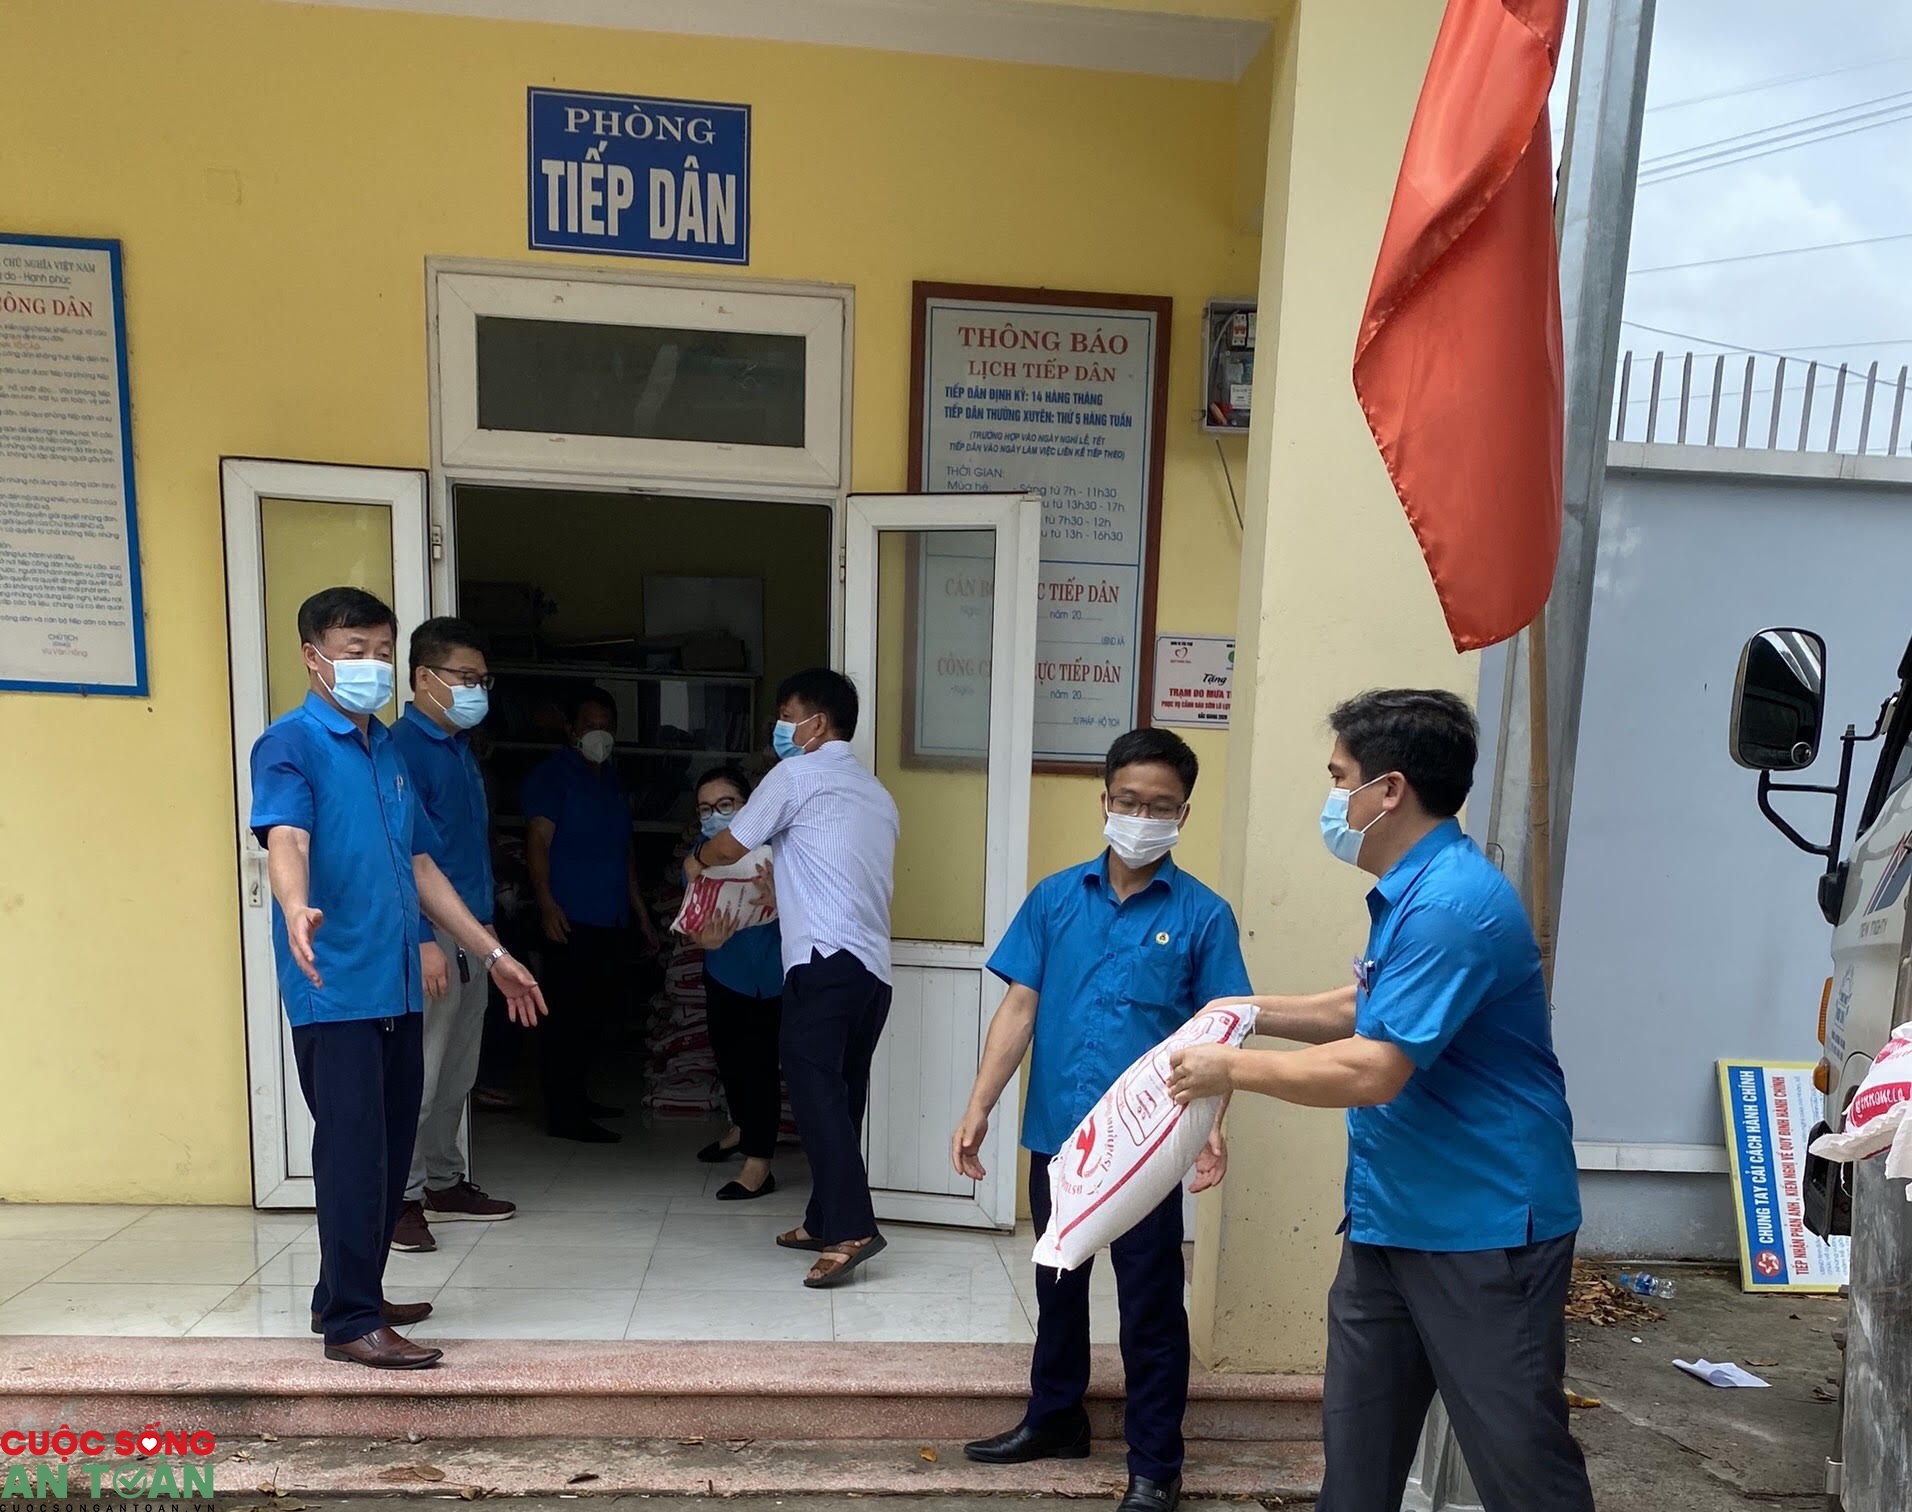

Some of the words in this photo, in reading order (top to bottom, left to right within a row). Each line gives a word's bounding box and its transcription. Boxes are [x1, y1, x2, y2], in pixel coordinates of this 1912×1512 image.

[564, 104, 716, 145] PHÒNG
[541, 140, 634, 237] TIẾP
[649, 155, 736, 246] DÂN
[3, 256, 20, 268] CHỦ
[24, 257, 52, 270] NGHĨA
[54, 259, 74, 272] VIỆT
[76, 262, 96, 273] NAM
[53, 295, 93, 318] DÂN
[958, 323, 1060, 352] THÔNG
[1070, 328, 1128, 355] BÁO
[968, 360, 1016, 380] LỊCH
[1023, 358, 1069, 379] TIẾP
[1075, 362, 1116, 382] DÂN
[945, 385, 964, 398] TIẾP
[968, 387, 986, 400] DÂN
[990, 388, 1012, 402] ĐỊNH
[1032, 391, 1042, 402] 14
[1045, 390, 1070, 404] HÀNG
[1074, 392, 1103, 406] THÁNG
[944, 404, 963, 418] TIẾP
[965, 405, 984, 420] DÂN
[987, 407, 1021, 422] THƯỜNG
[1076, 413, 1080, 425] 5
[1084, 412, 1106, 426] HÀNG
[1110, 413, 1132, 428] TUẦN
[947, 465, 970, 477] THỜI
[1064, 485, 1076, 496] 7h
[1088, 486, 1117, 498] 11h30
[1067, 500, 1096, 511] 13h30
[1107, 500, 1125, 512] 17h
[1058, 514, 1084, 526] 7h30
[1094, 516, 1112, 527] 12h
[1066, 528, 1083, 540] 13h
[1094, 530, 1123, 542] 16h30
[1050, 576, 1084, 603] TIẾP
[1088, 579, 1120, 604] DÂN
[1050, 609, 1068, 620] năm
[1059, 657, 1090, 683] TIẾP
[1094, 660, 1121, 684] DÂN
[1203, 673, 1227, 686] Tặng
[1050, 689, 1068, 700] năm
[1170, 688, 1192, 698] TRẠM
[1738, 1070, 1758, 1102] CHÍNH
[1771, 1076, 1787, 1097] CHÍNH
[1774, 1099, 1789, 1118] HÀNH
[1742, 1105, 1760, 1132] HÀNH
[1746, 1136, 1764, 1164] CÁCH
[1779, 1137, 1794, 1150] QUY
[1776, 1151, 1794, 1160] VỀ
[1745, 1166, 1767, 1183] CẢI
[1782, 1162, 1798, 1178] NGHỊ
[1753, 1186, 1769, 1204] TAY
[1780, 1180, 1798, 1196] KIẾN
[1756, 1208, 1774, 1244] CHUNG
[1784, 1218, 1804, 1237] PHẢN
[1790, 1238, 1808, 1258] NHẬN
[1791, 1260, 1809, 1274] TIẾP
